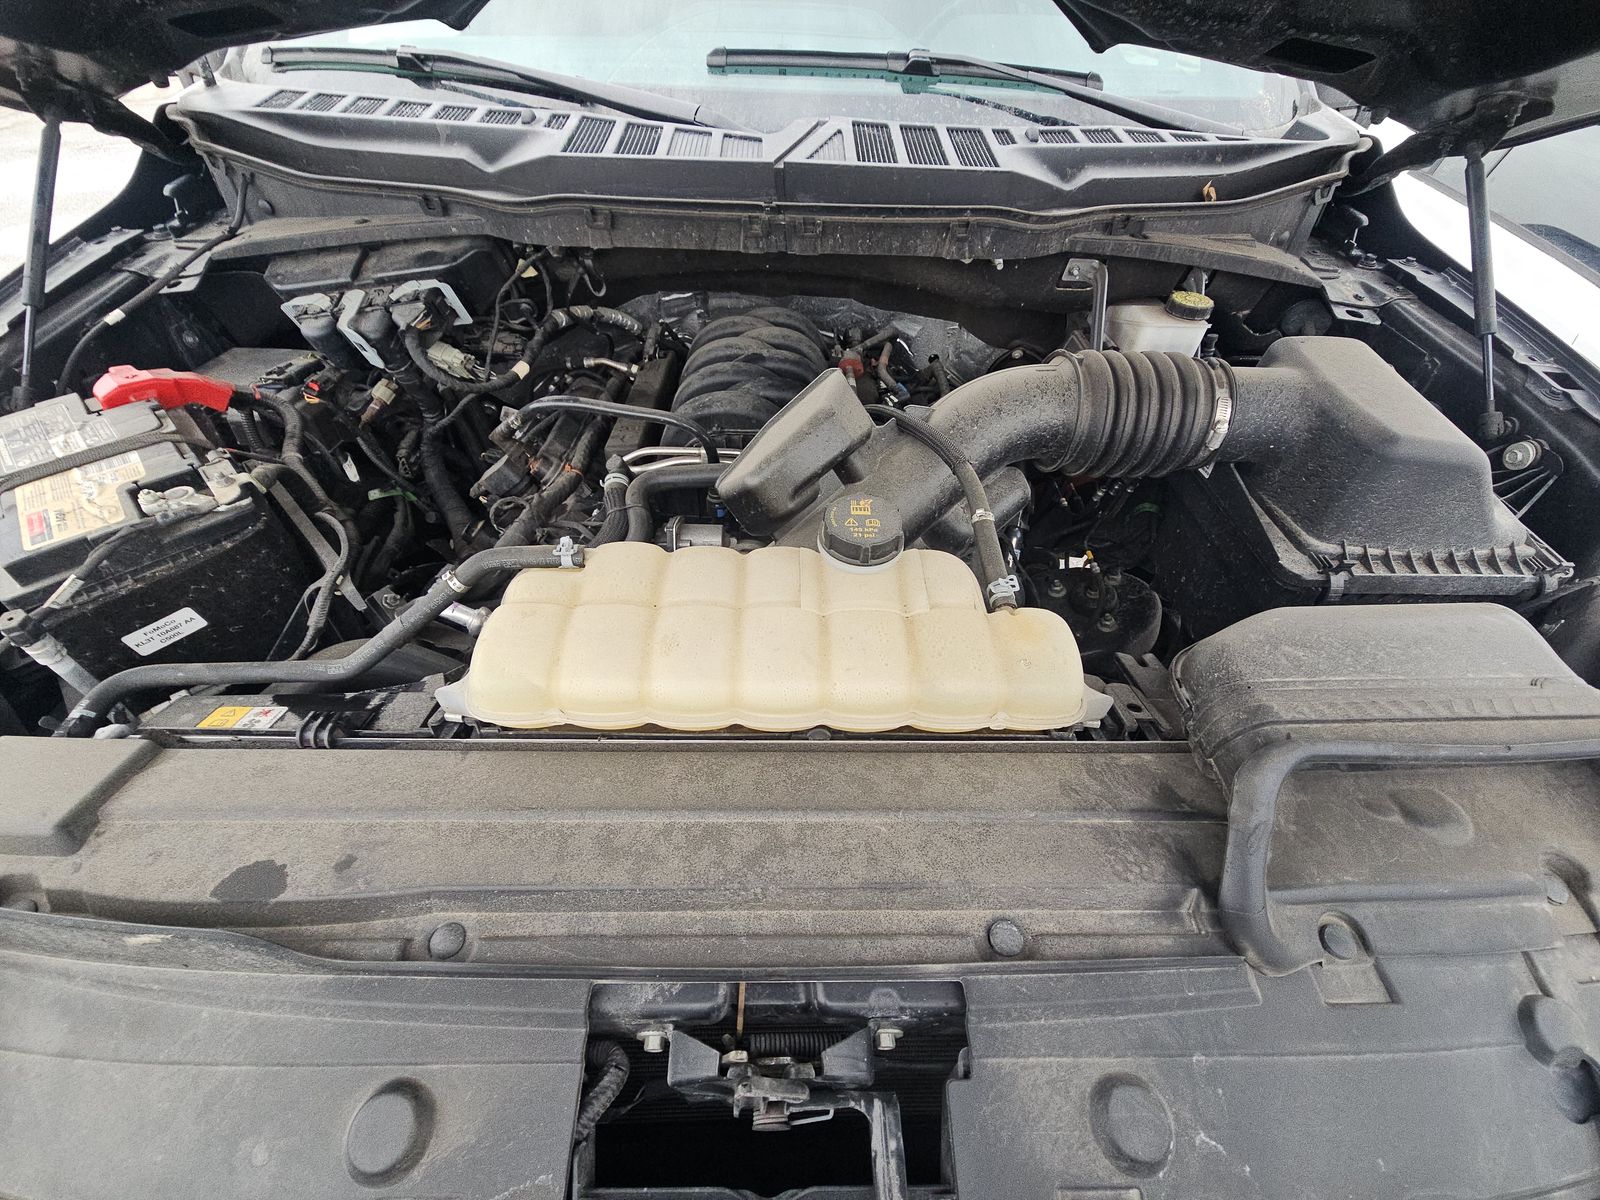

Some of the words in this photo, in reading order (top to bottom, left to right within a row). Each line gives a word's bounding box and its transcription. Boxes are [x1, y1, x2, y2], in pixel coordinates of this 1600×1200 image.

[134, 636, 155, 648] KL3T
[184, 616, 196, 624] AA
[143, 619, 176, 636] FoMoCo
